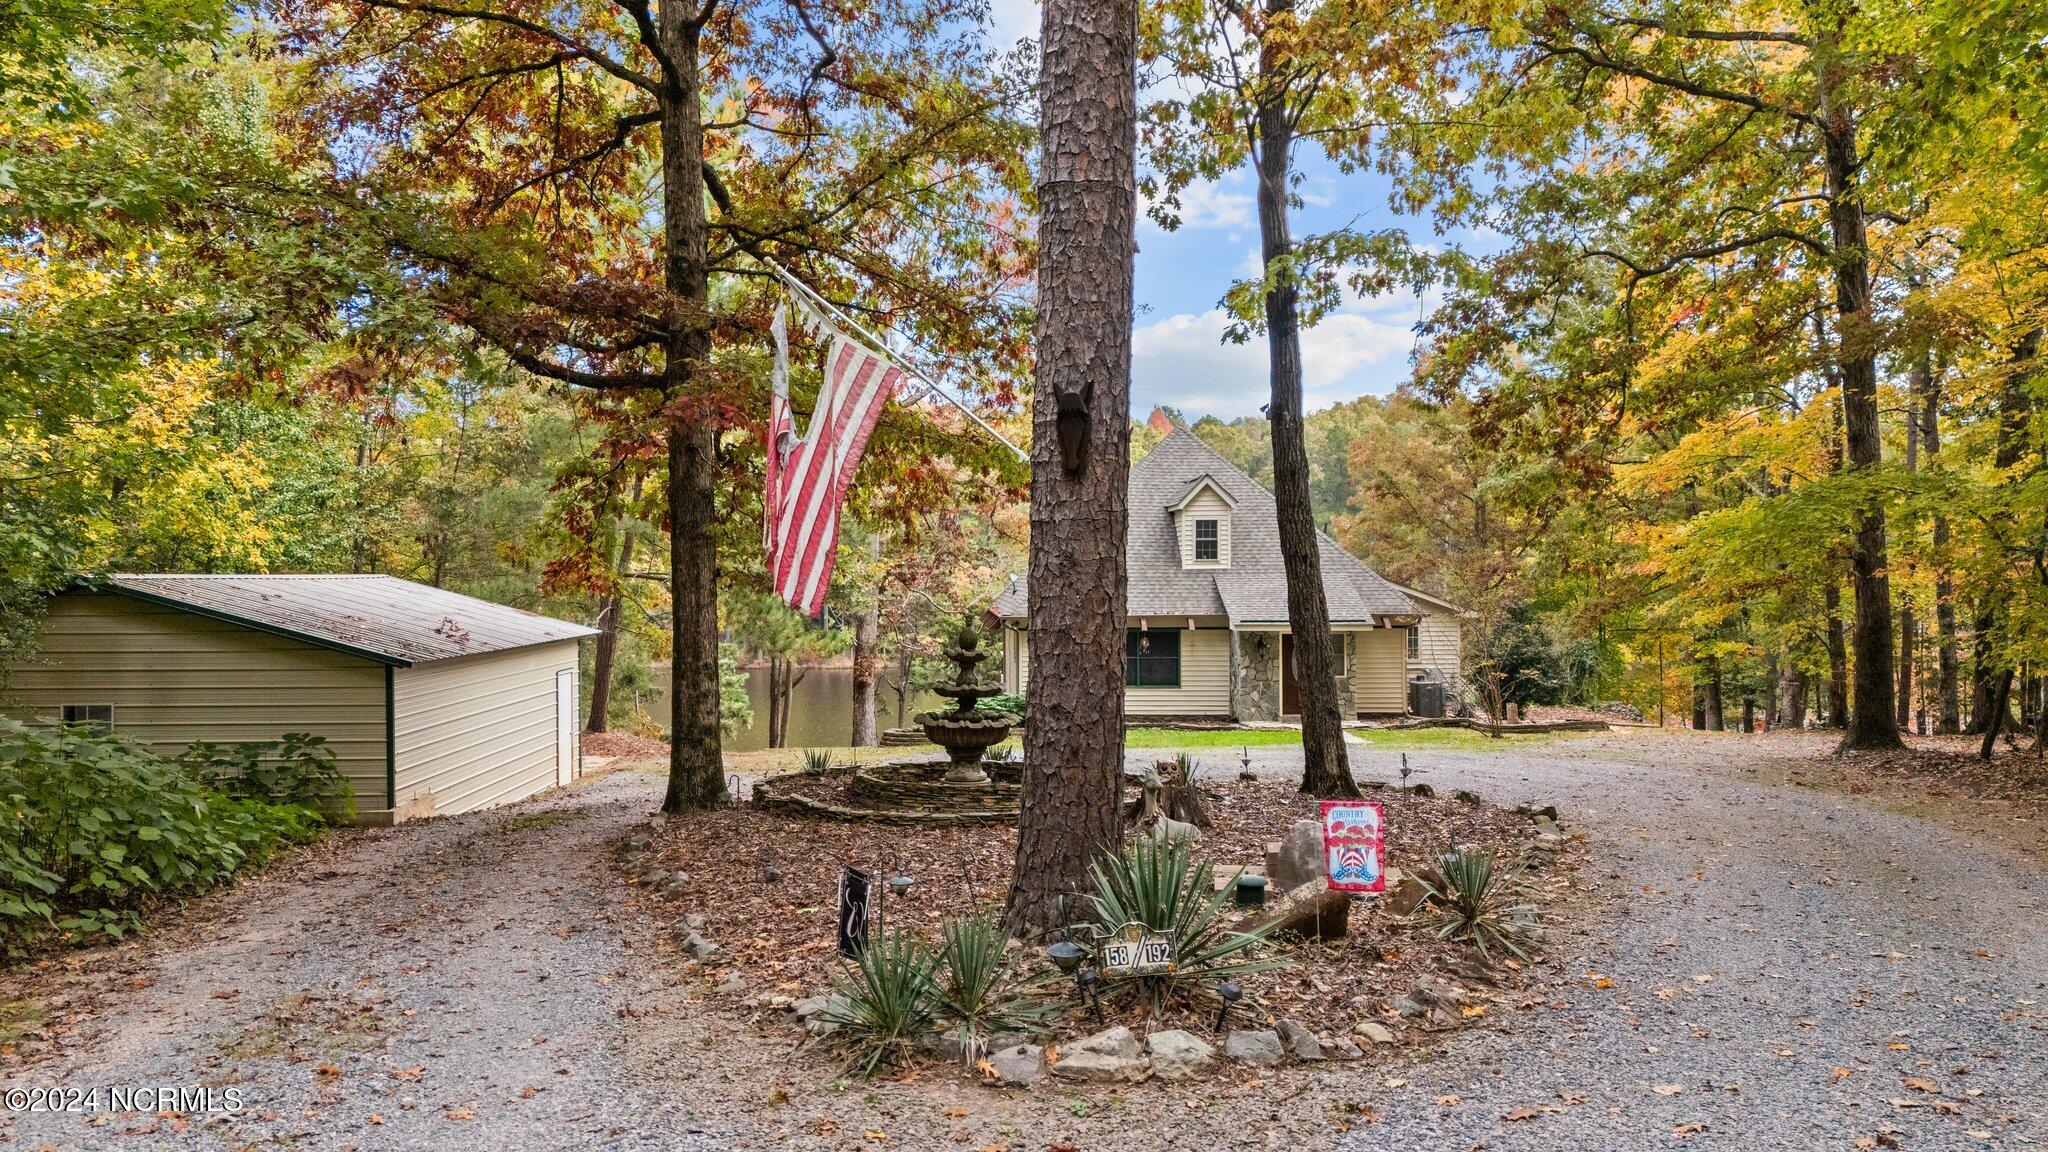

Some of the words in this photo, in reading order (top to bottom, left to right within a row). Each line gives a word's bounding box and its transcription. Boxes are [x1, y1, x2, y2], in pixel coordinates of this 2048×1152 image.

[1332, 810, 1365, 820] COUNTRY
[1104, 947, 1129, 966] 158
[1146, 943, 1171, 963] 192
